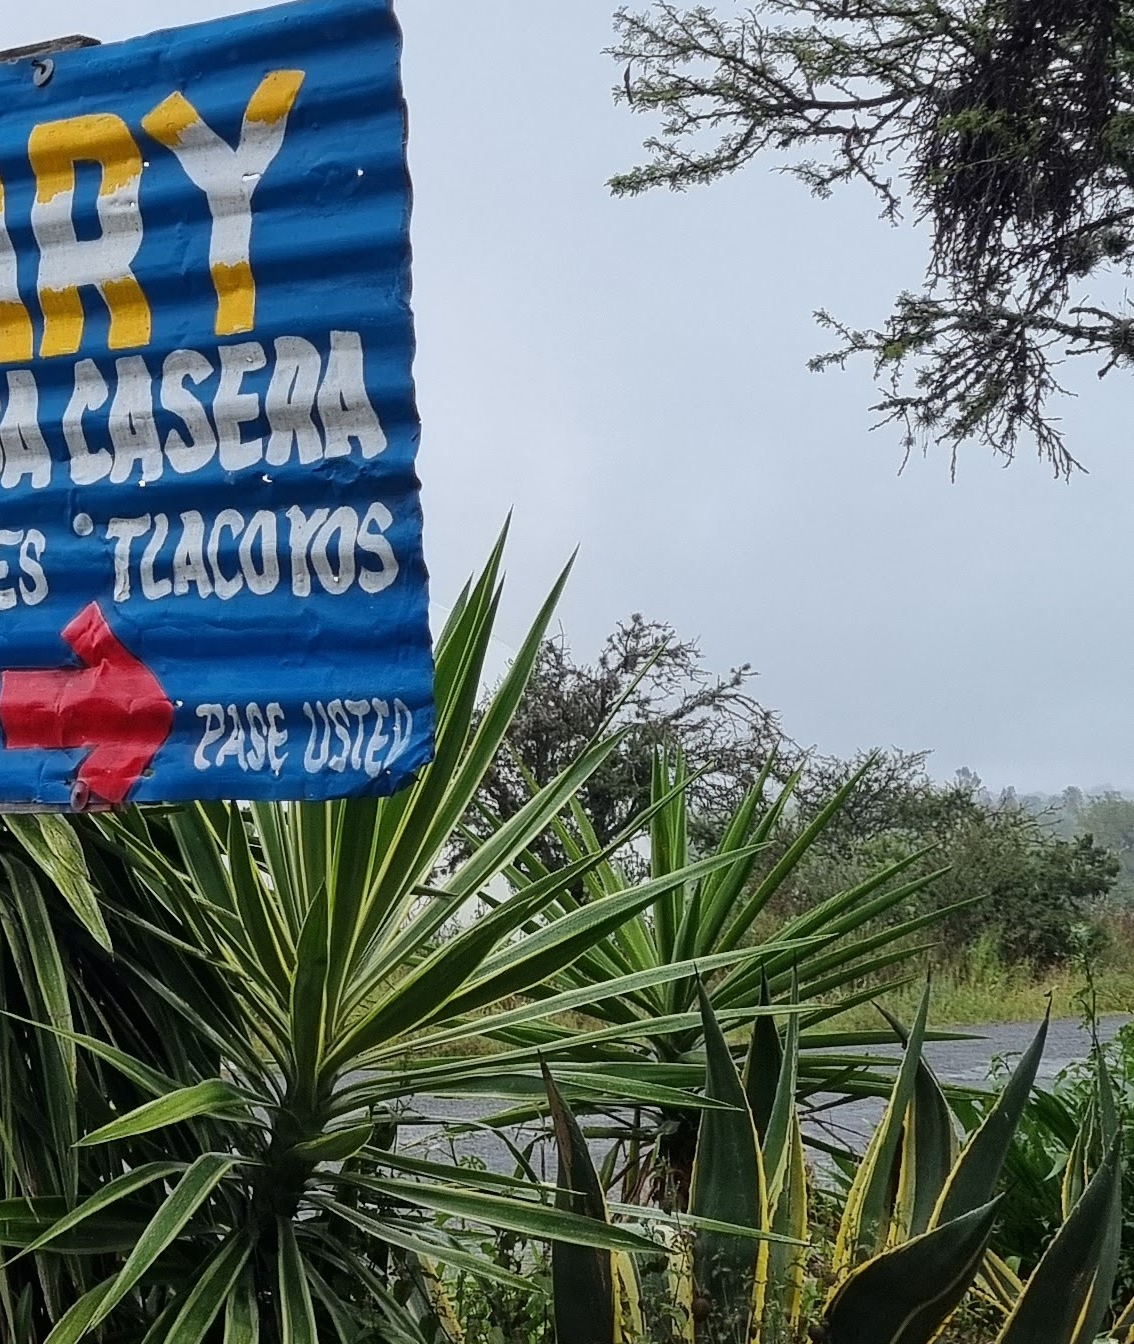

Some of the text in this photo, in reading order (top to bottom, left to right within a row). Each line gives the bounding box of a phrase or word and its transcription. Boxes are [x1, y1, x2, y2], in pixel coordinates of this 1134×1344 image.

[63, 331, 387, 485] CASERA
[106, 501, 400, 602] TLACOYOS
[194, 697, 414, 778] PASE USTED
